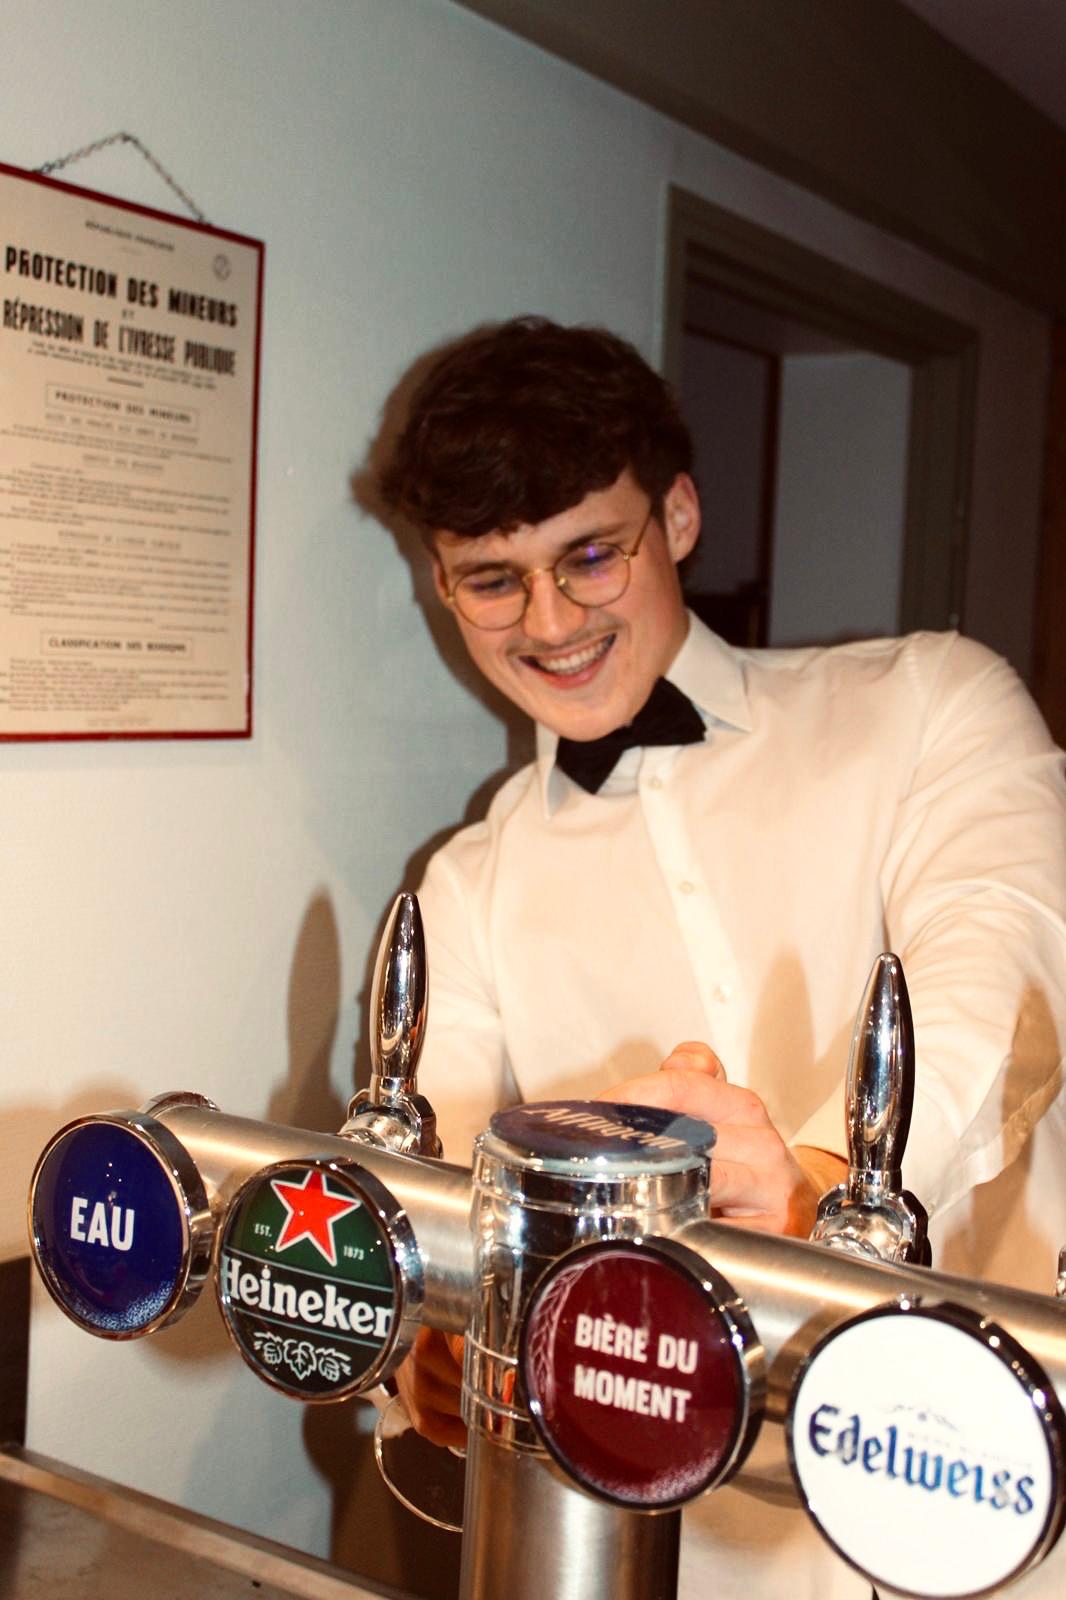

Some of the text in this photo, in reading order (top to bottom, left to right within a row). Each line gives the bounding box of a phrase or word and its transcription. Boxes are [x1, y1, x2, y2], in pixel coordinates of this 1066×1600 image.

[5, 246, 238, 328] PROTECTION DES MINEURS
[3, 297, 84, 343] RÉPRESSION
[93, 320, 110, 350] DE
[70, 1196, 135, 1251] EAU
[254, 1222, 366, 1261] EST. 1873
[574, 1312, 699, 1374] BIÈRE DU
[573, 1363, 693, 1424] MOMENT
[808, 1403, 1035, 1515] Edelweiss
